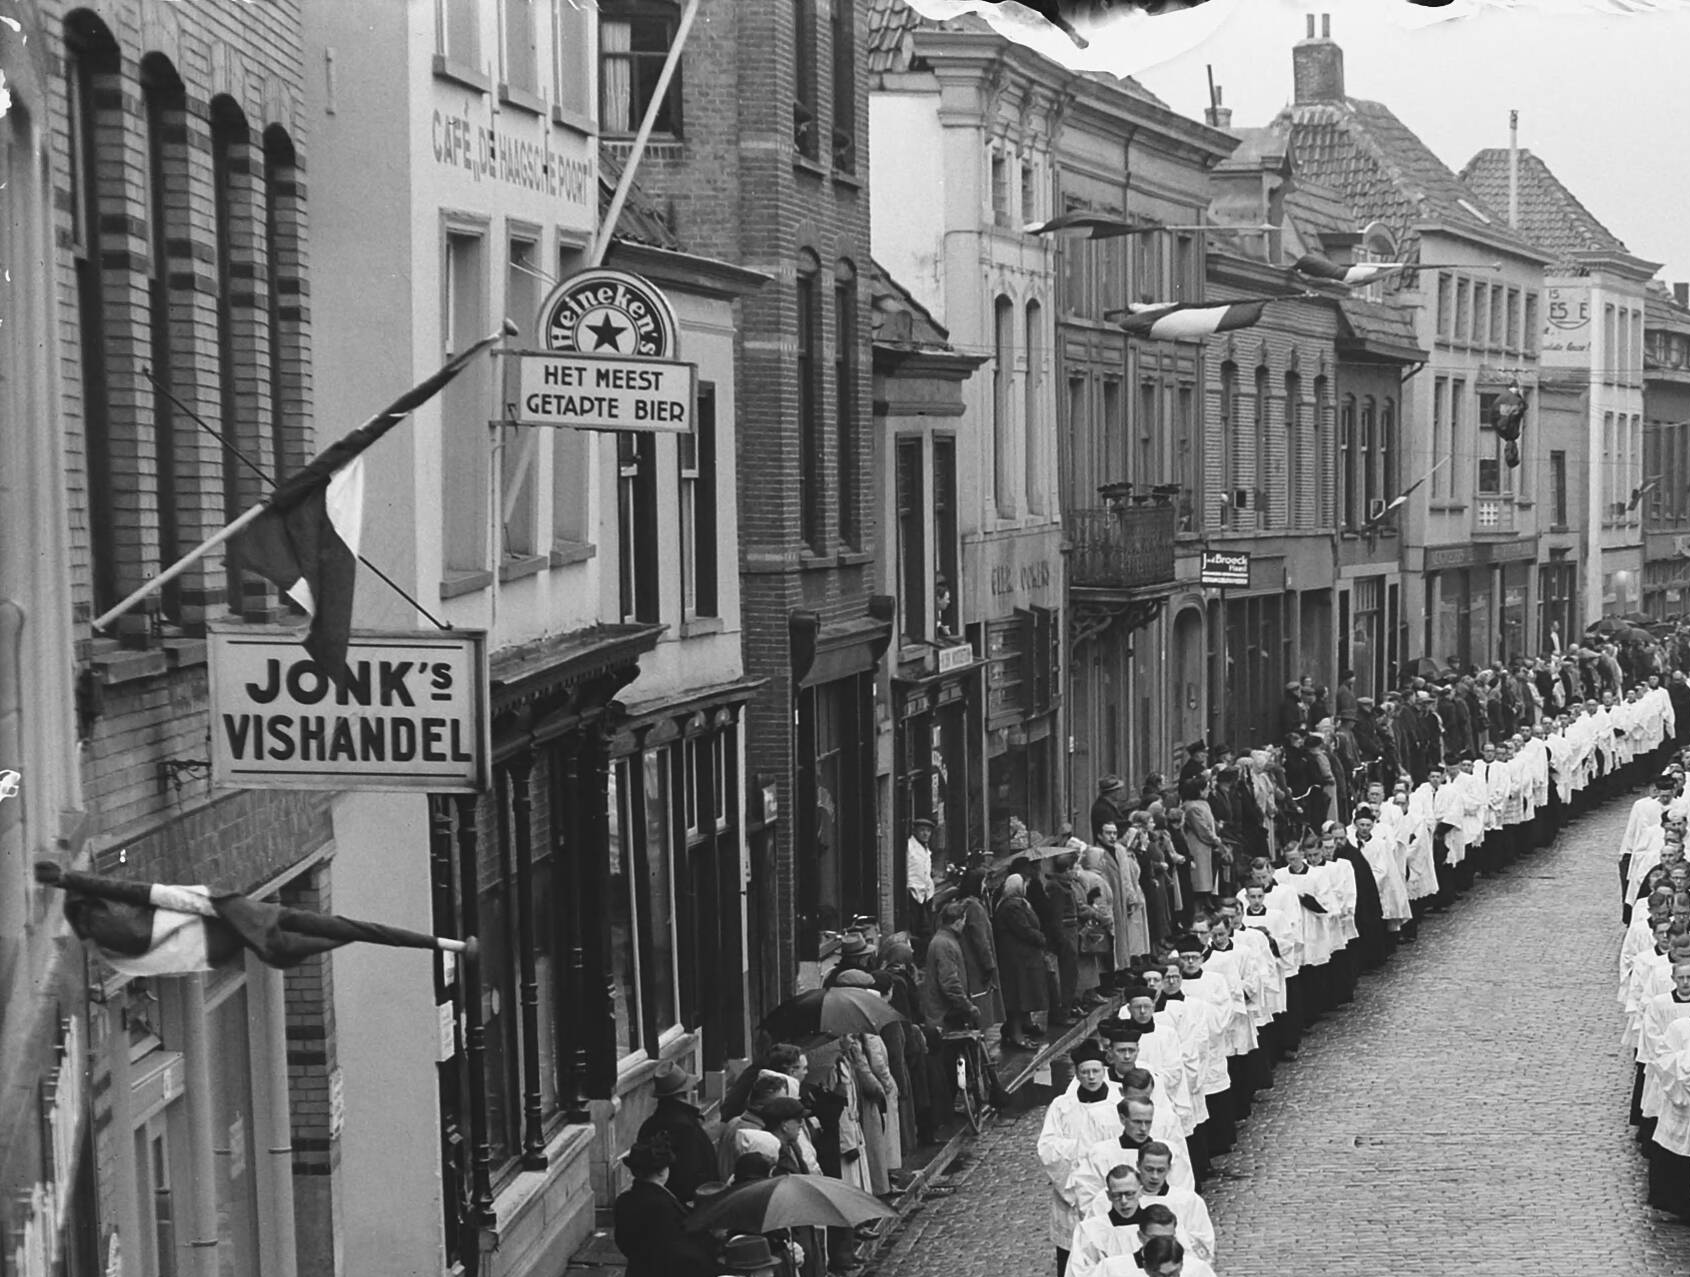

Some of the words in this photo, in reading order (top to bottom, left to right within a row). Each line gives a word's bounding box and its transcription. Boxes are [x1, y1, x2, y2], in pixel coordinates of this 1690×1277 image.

[431, 99, 472, 170] CAFÉ
[500, 133, 556, 196] HAAGSCHE
[551, 285, 658, 356] Heineken's
[544, 364, 587, 387] HET
[596, 367, 663, 391] MEEST
[526, 393, 620, 418] GETAPTE
[634, 399, 685, 422] BIER
[222, 713, 473, 763] VISHANDEL
